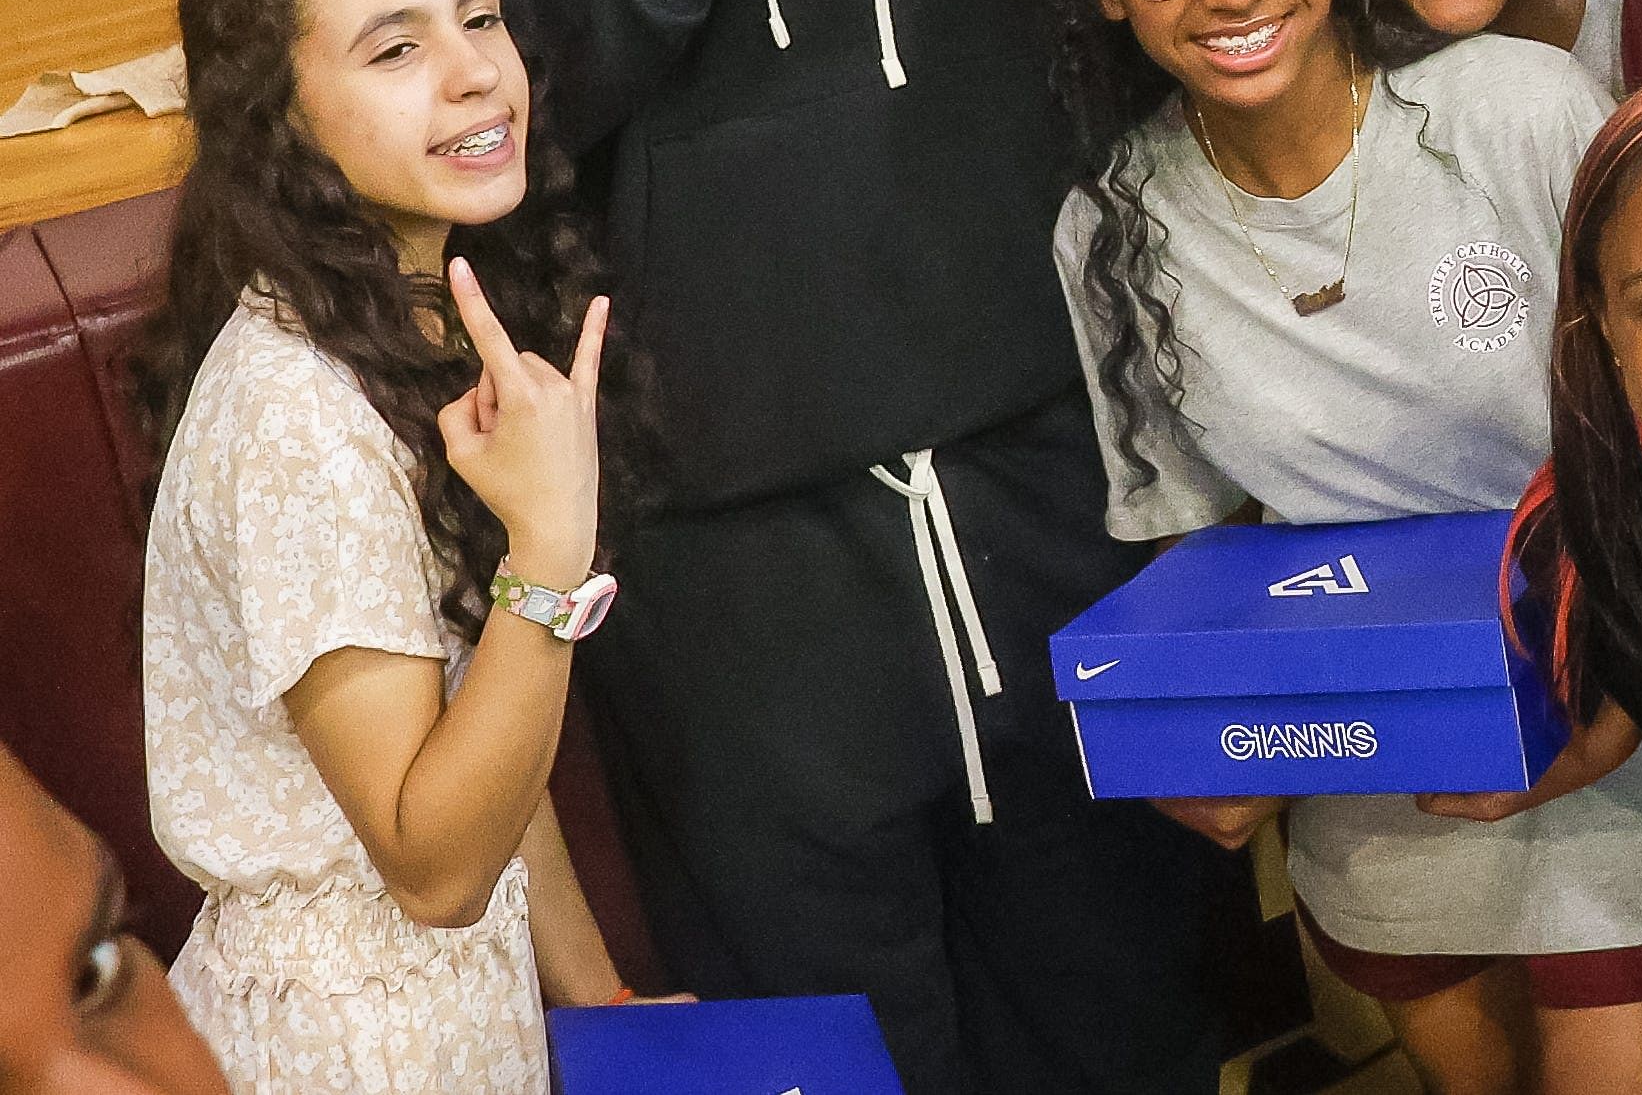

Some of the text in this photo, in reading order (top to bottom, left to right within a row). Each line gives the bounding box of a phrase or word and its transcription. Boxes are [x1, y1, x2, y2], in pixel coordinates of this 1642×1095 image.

[1430, 243, 1532, 326] TRINITY CATHOLIC
[1454, 297, 1530, 352] ACADEMY
[1220, 721, 1378, 761] GIANNIS
